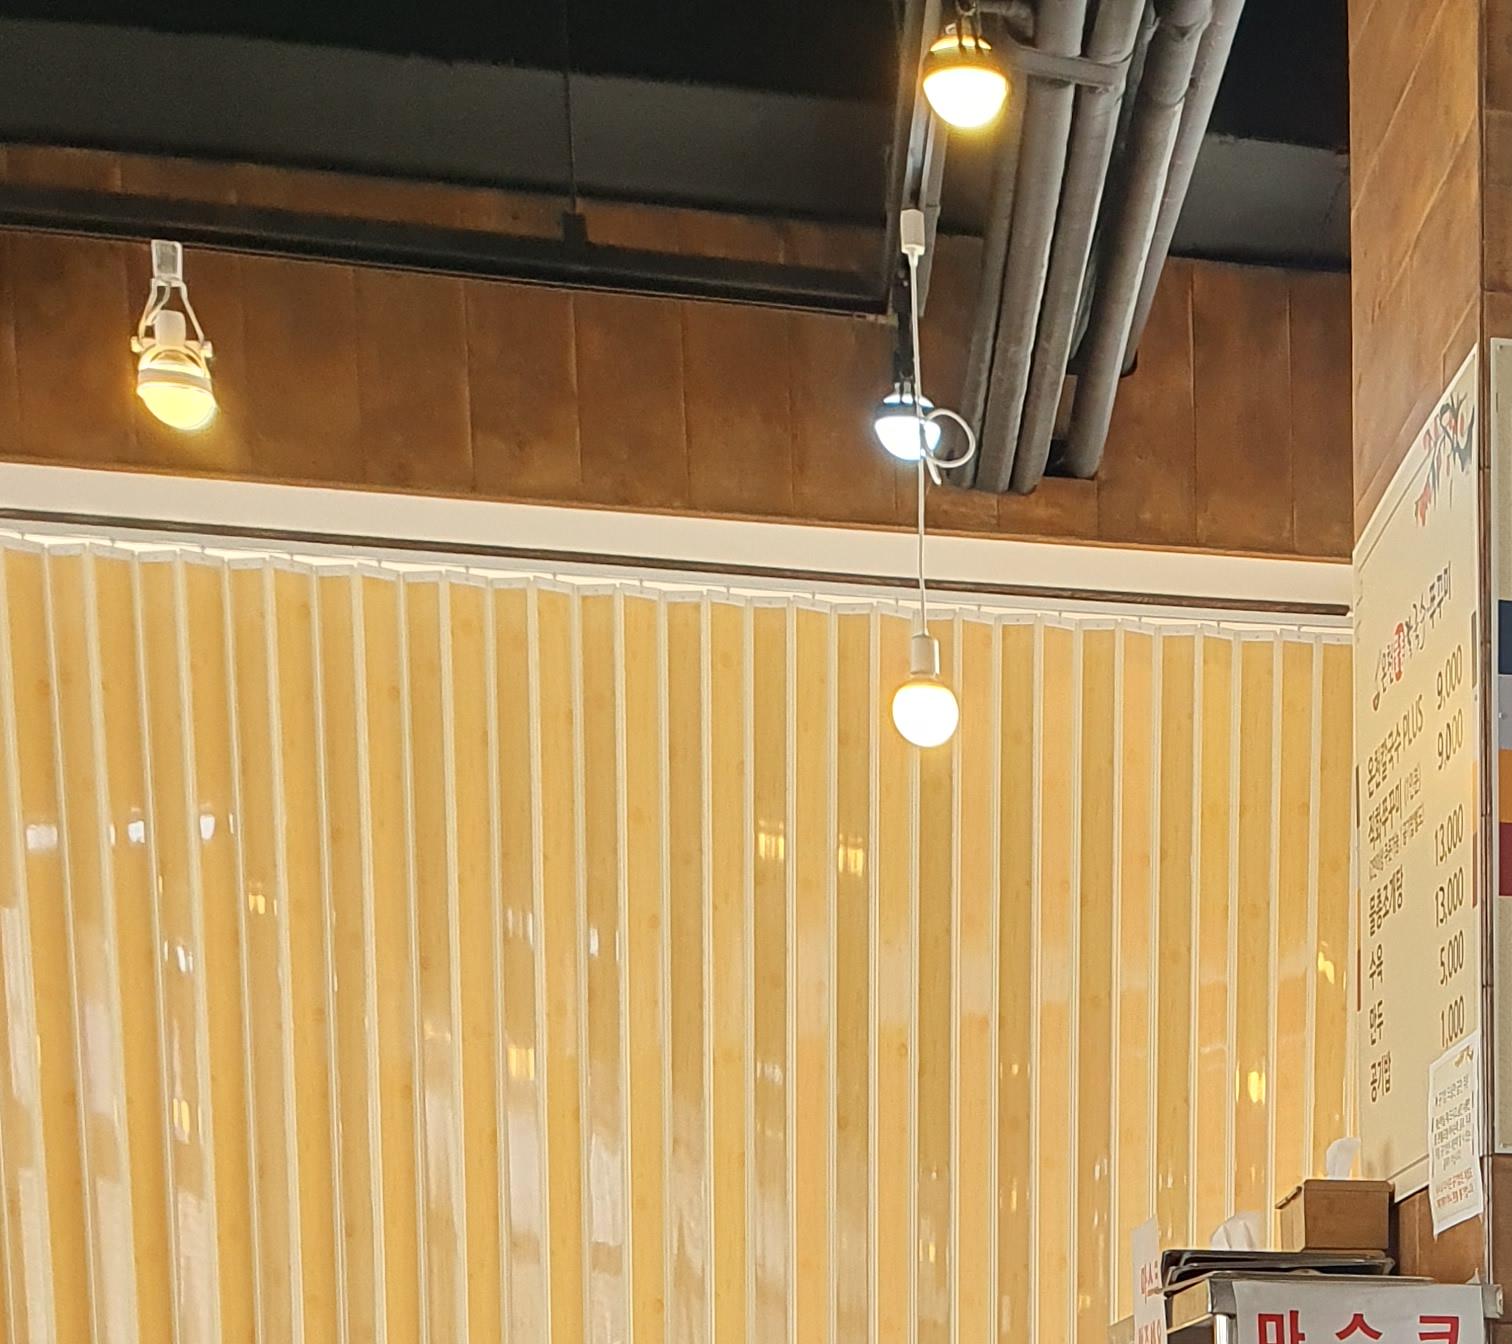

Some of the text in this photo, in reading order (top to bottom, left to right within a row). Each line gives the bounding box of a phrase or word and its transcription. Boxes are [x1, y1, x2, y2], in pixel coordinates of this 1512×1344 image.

[1436, 644, 1462, 711] 9,000
[1436, 708, 1463, 772] 9,000
[1434, 803, 1463, 867] 13,000
[1434, 866, 1464, 928] 13,000
[1439, 929, 1464, 986] 5,000
